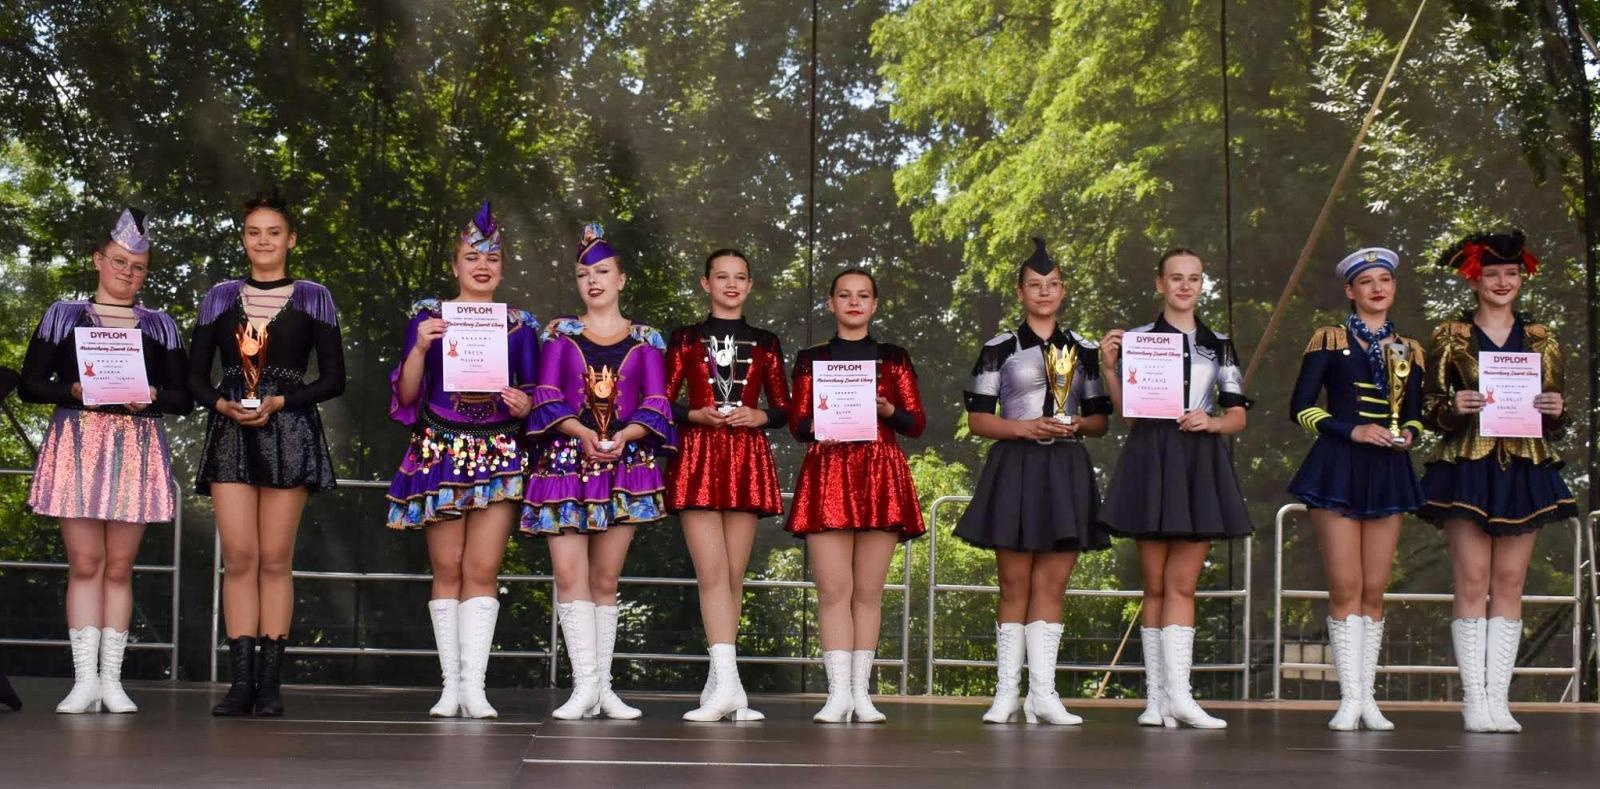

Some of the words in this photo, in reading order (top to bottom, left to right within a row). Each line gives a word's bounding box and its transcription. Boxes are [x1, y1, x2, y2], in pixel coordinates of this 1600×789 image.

[457, 306, 493, 314] DYPLOM
[90, 331, 127, 339] DYPLOM
[1136, 336, 1170, 344] DYPLOM
